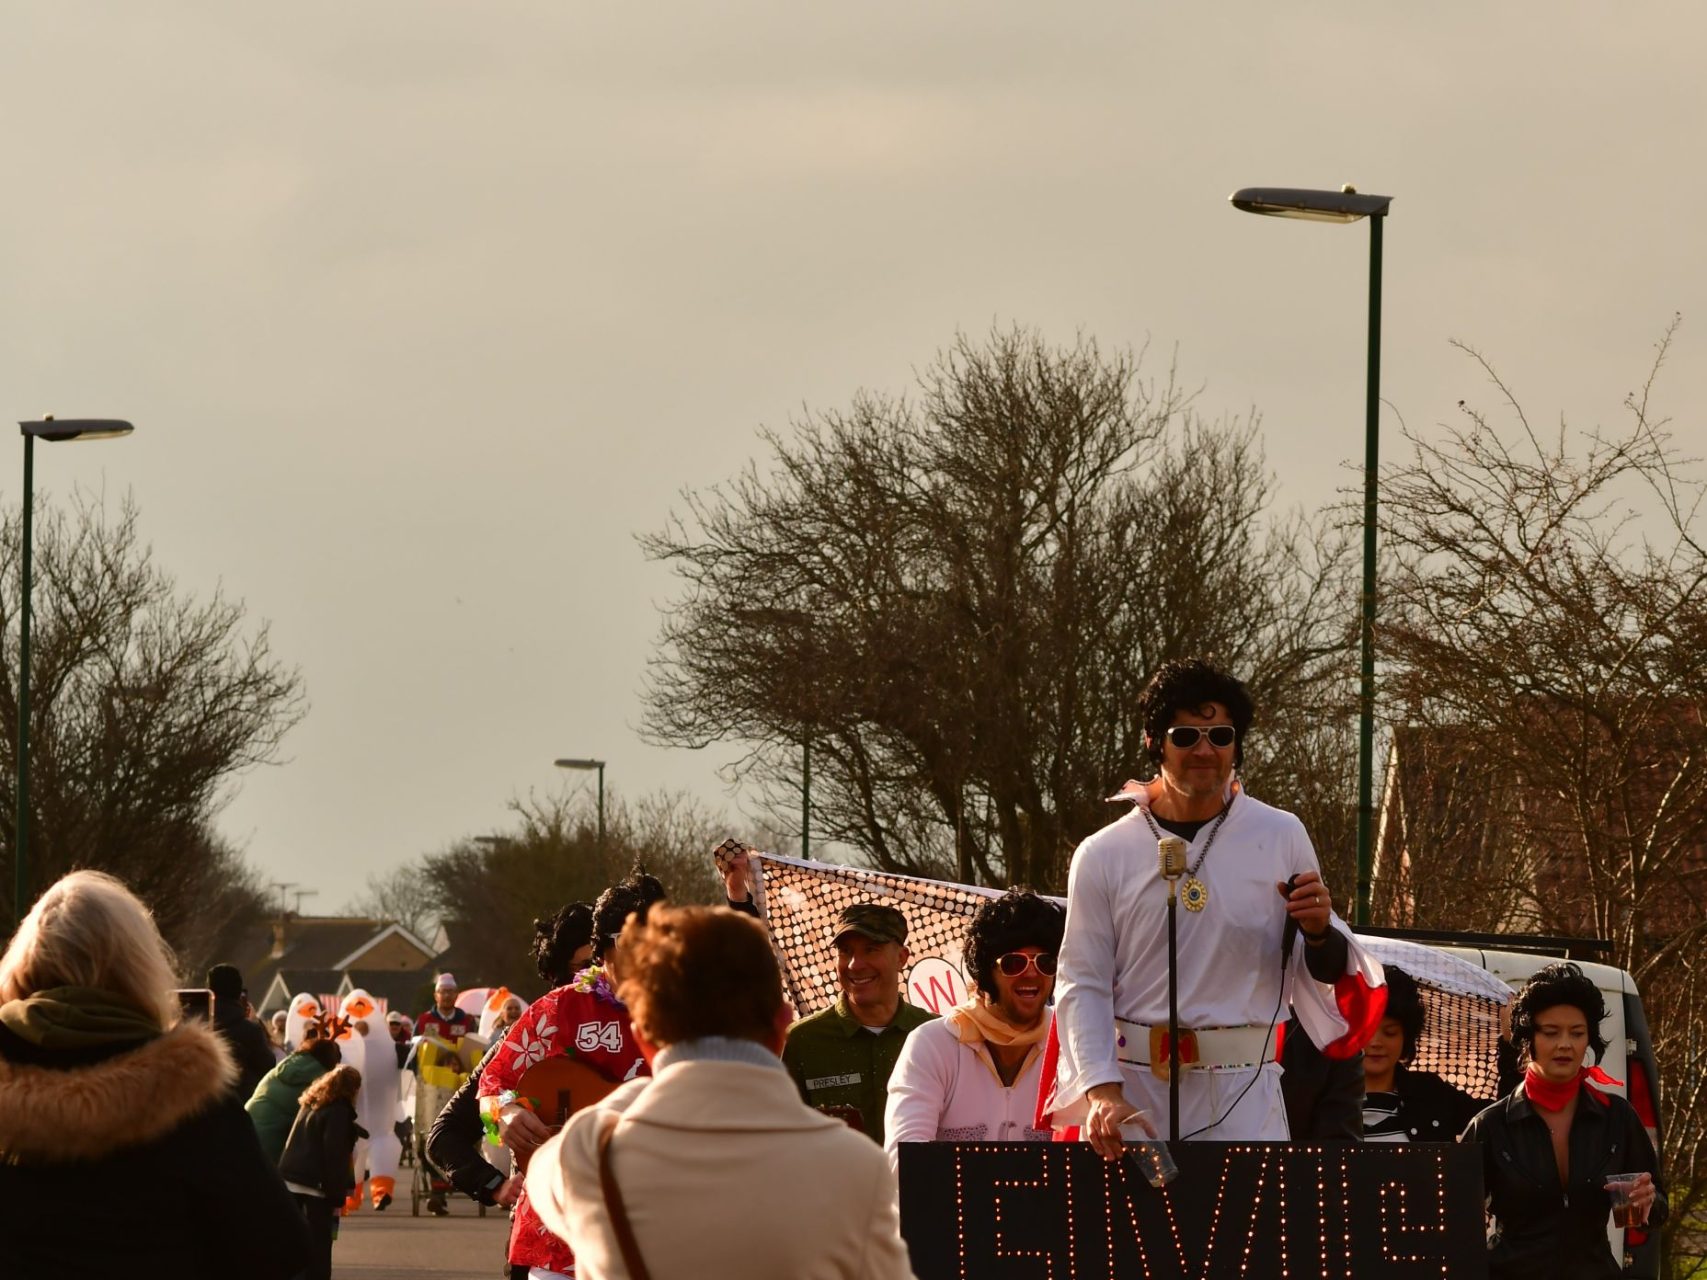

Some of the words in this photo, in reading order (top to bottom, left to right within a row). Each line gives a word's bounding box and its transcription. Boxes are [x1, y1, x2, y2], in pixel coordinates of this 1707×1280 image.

[913, 969, 957, 1015] W
[575, 1020, 623, 1053] 54
[813, 1075, 851, 1090] PRESLEY
